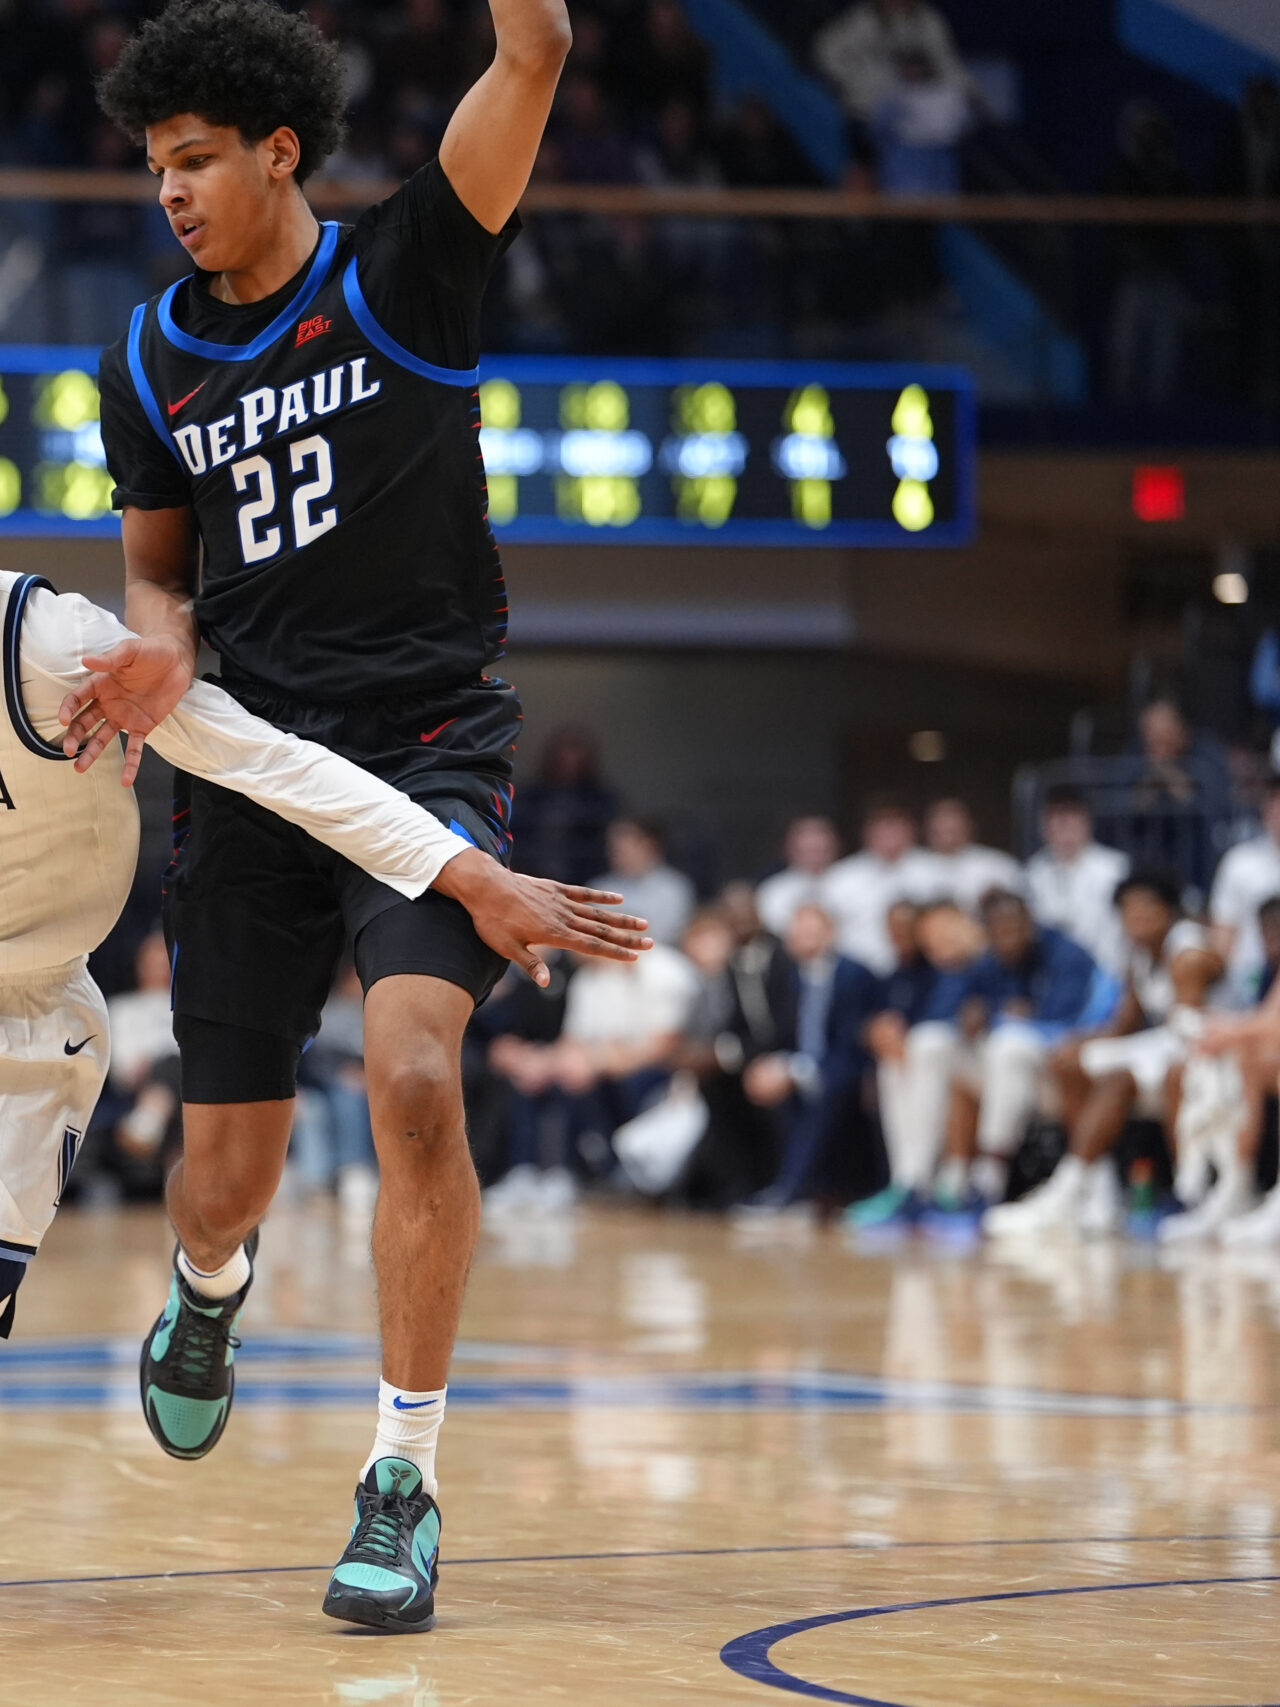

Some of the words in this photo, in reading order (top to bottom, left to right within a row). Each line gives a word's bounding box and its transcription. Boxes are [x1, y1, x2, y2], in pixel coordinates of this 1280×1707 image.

[296, 319, 332, 343] EAST
[298, 314, 324, 332] BIG
[230, 433, 339, 567] 22
